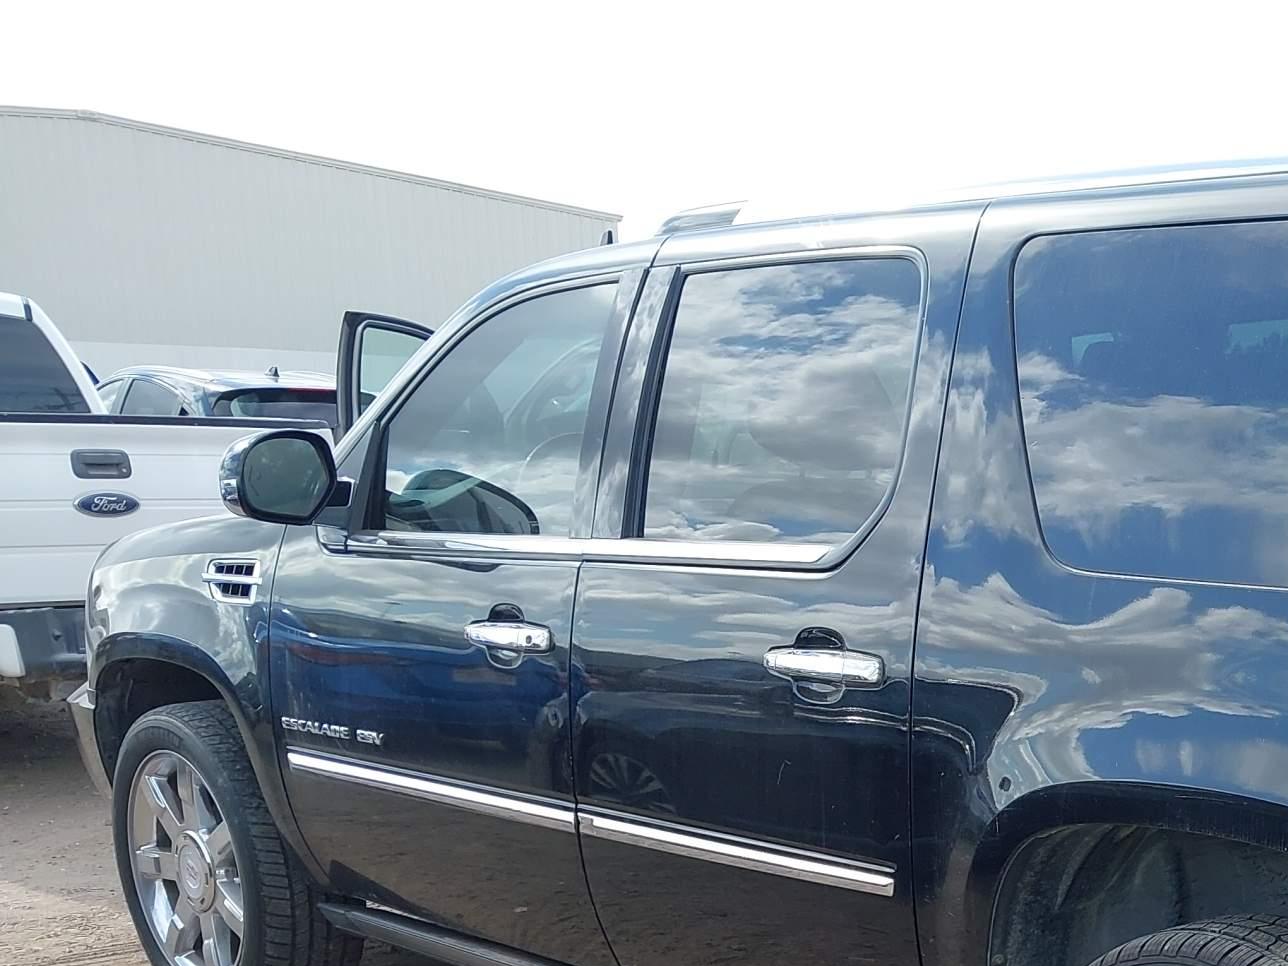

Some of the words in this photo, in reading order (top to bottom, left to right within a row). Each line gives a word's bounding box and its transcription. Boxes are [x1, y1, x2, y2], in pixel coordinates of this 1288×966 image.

[91, 496, 127, 511] Ford
[281, 716, 351, 740] ESCALADE
[356, 729, 384, 746] ESV
